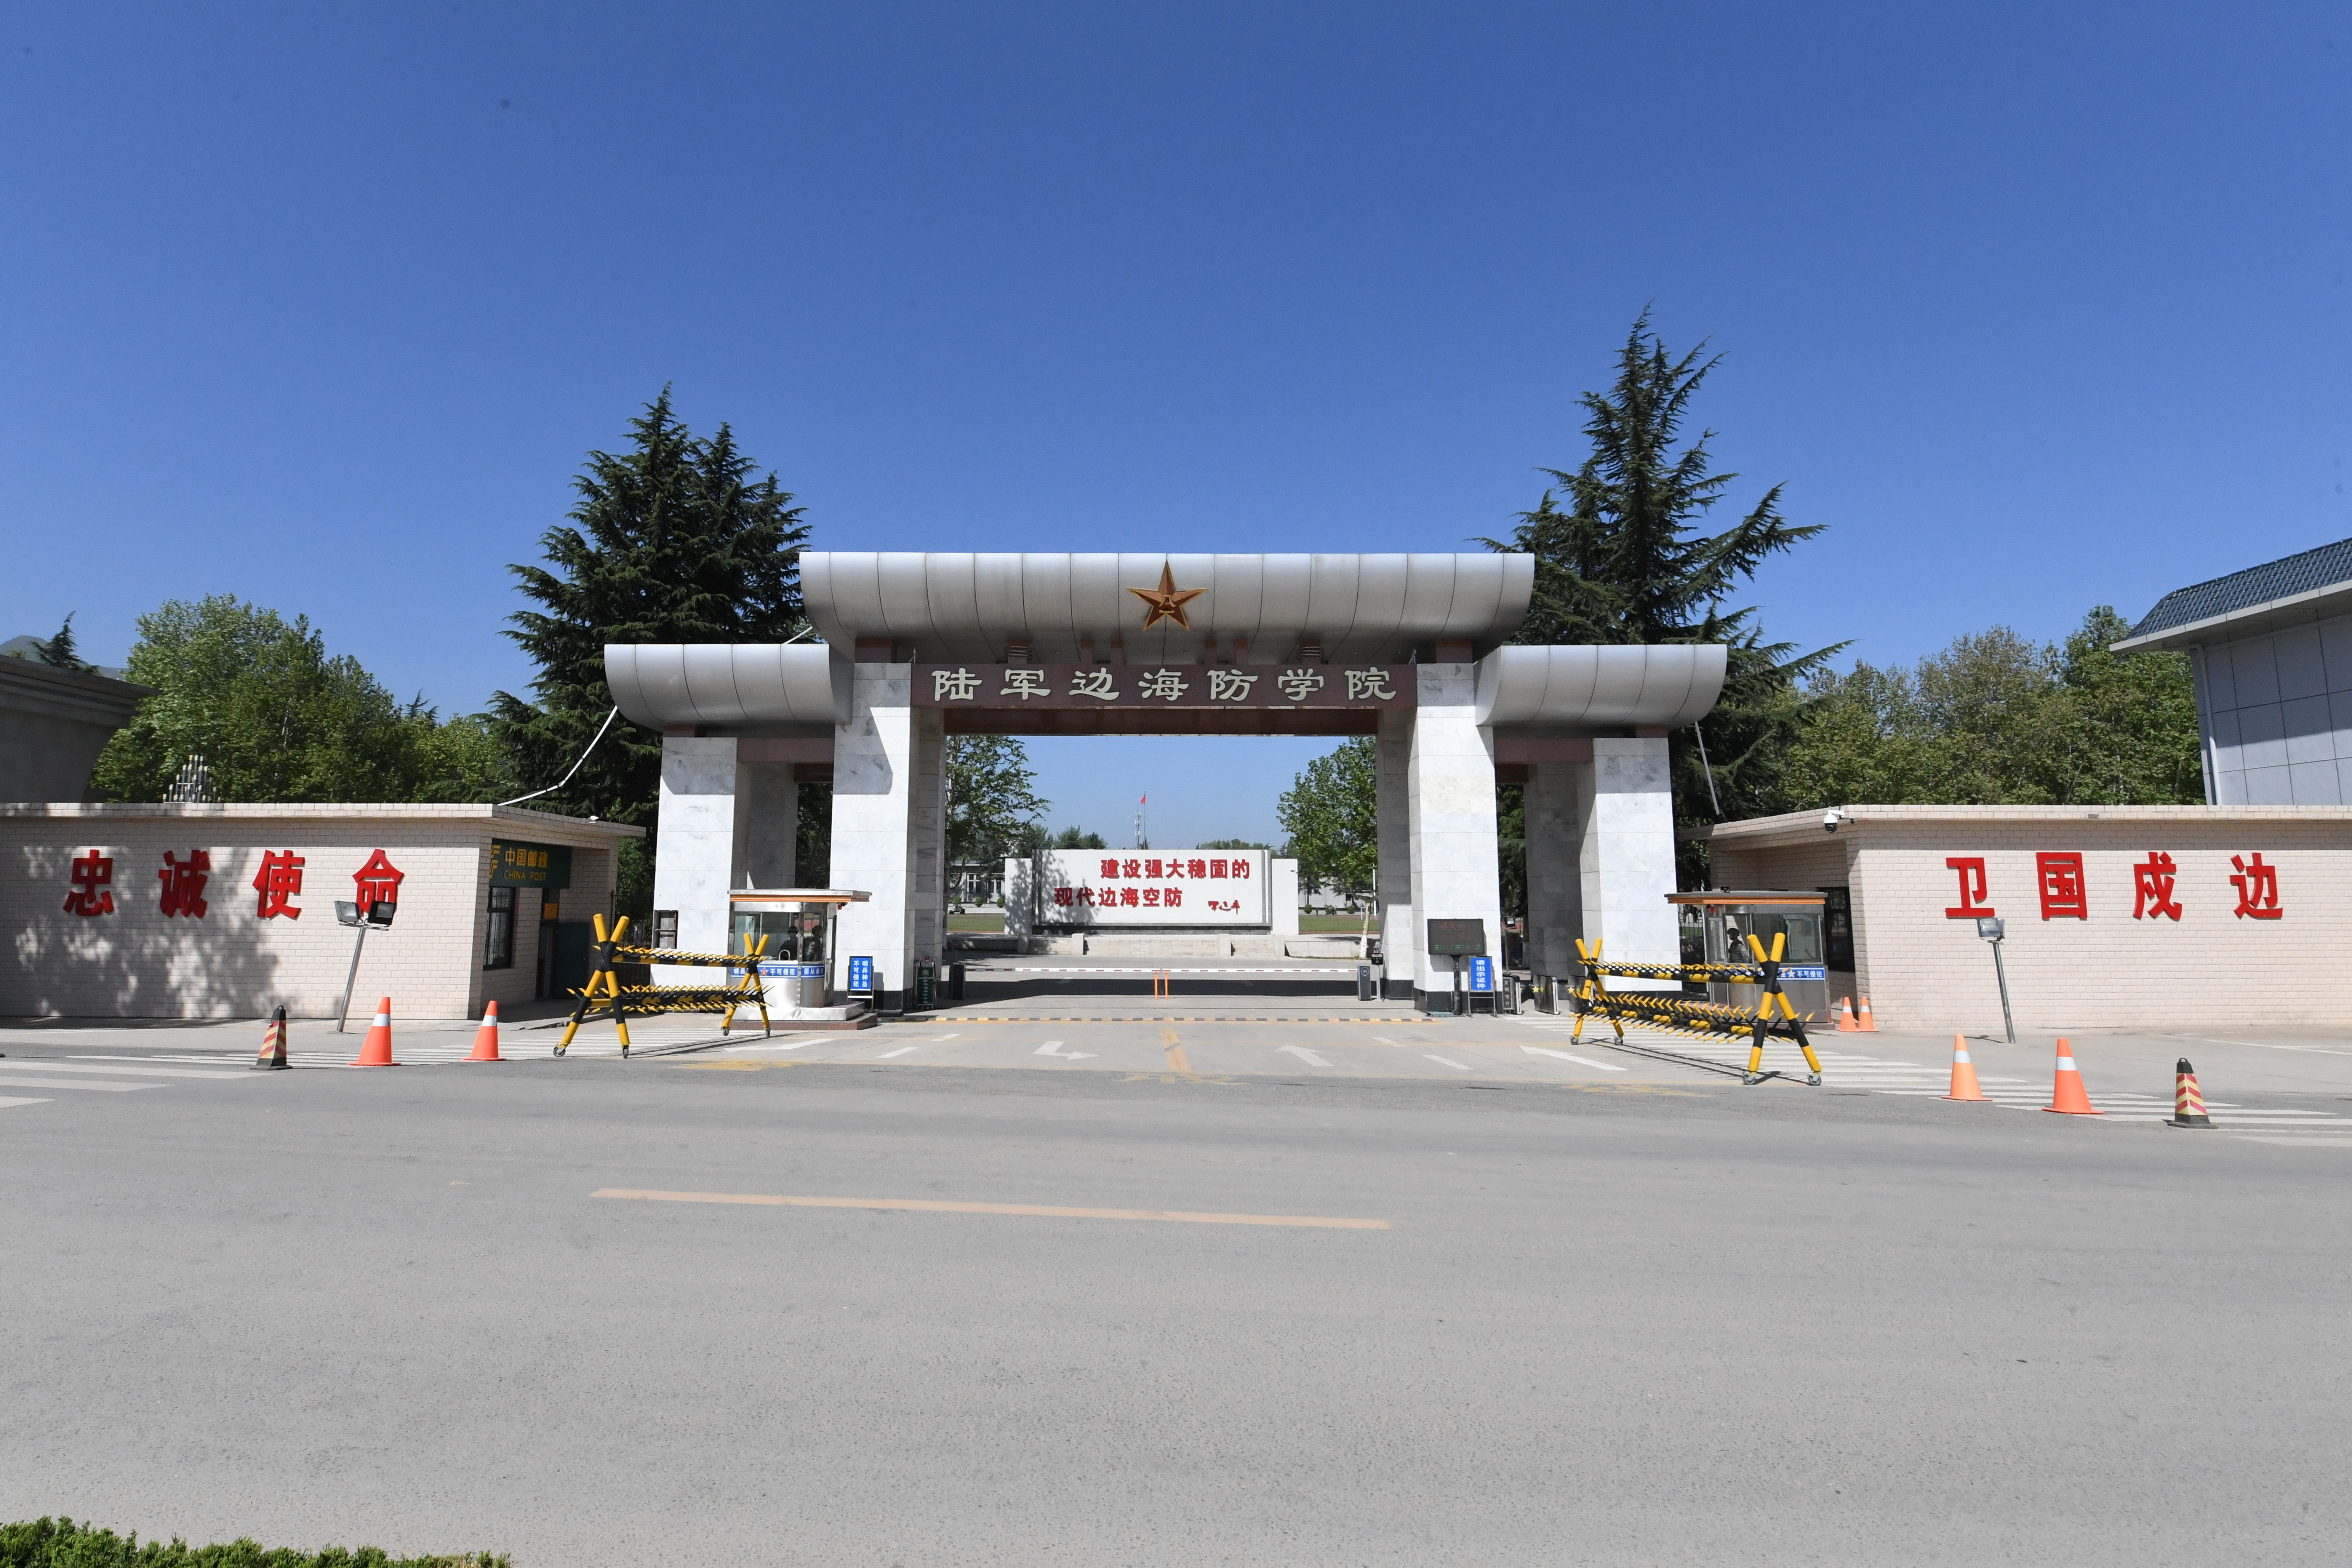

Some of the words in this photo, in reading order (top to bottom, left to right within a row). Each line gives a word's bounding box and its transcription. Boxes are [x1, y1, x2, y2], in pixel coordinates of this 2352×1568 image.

[931, 667, 1396, 702] 陆军边海防学院
[505, 847, 547, 868] 中国邮政
[1100, 858, 1250, 879] 建设强大稳固的
[63, 849, 405, 918] 忠诚使命
[504, 870, 525, 879] CHINA
[530, 872, 546, 881] POST
[1945, 852, 2283, 920] 卫国戍边
[1054, 887, 1183, 907] 现代边海空防
[1475, 960, 1486, 988] 请出示证件
